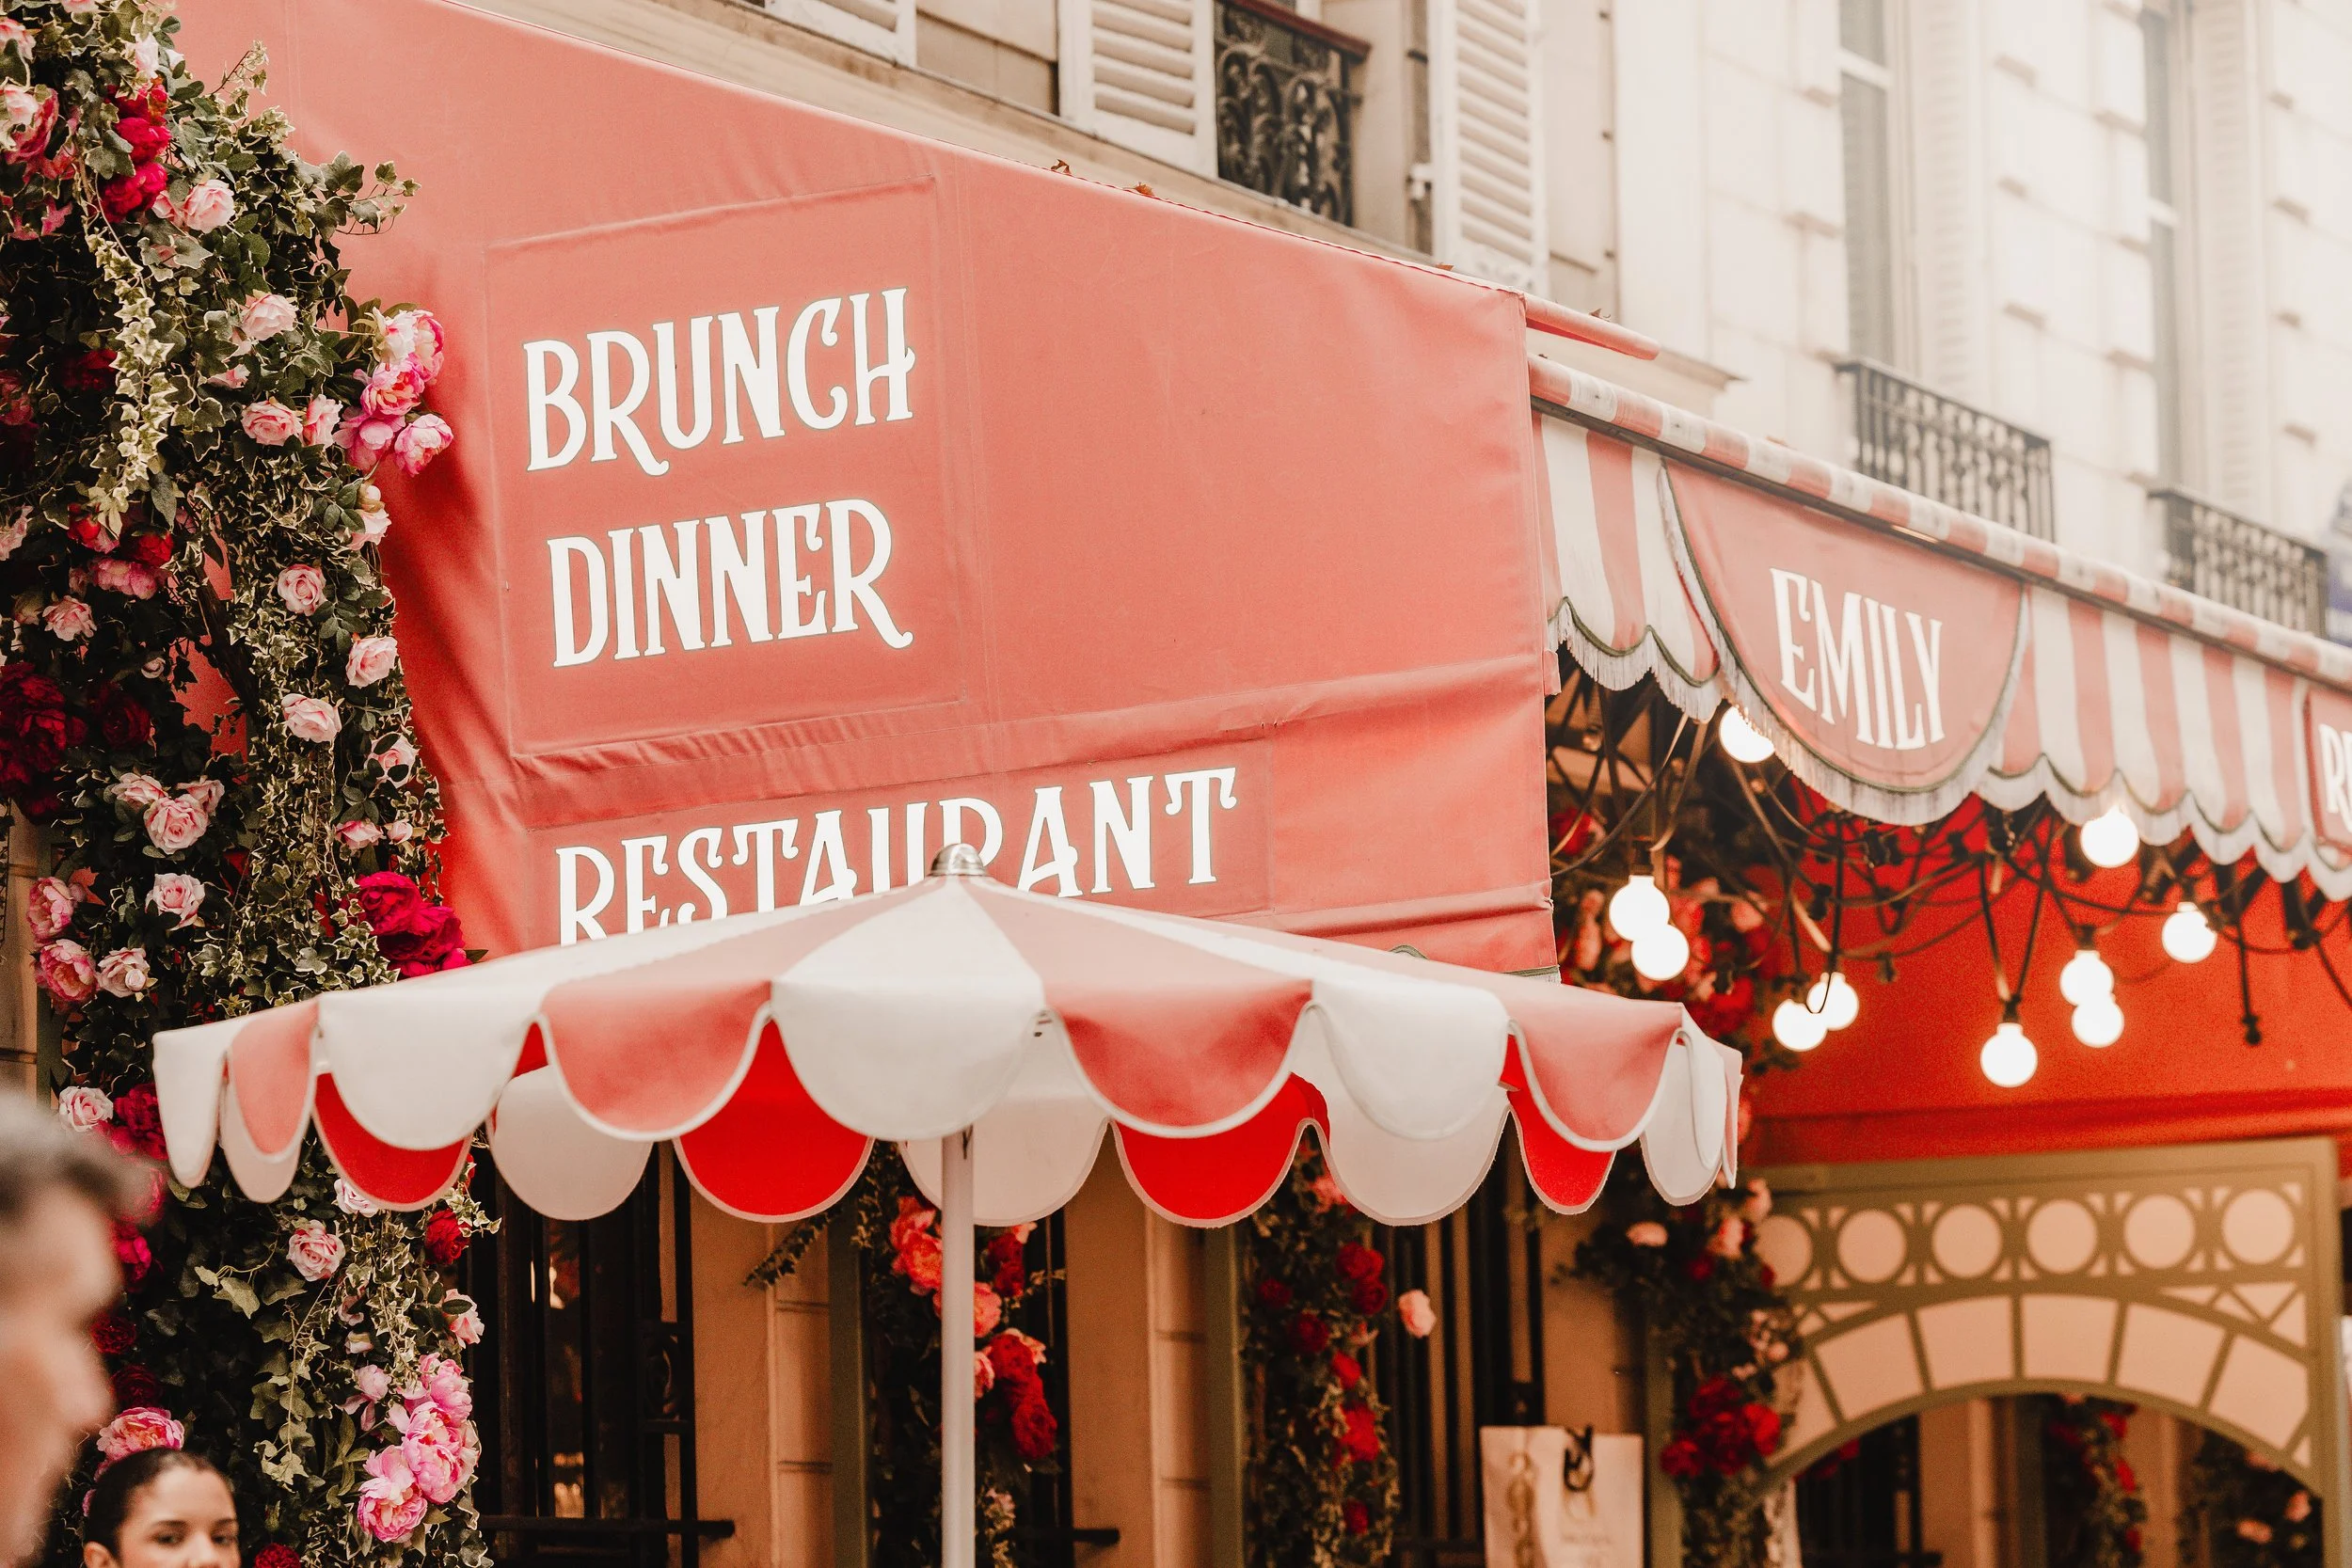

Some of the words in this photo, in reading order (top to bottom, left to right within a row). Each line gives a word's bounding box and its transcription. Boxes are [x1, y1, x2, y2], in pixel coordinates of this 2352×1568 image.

[523, 288, 915, 476] BRUNCH
[548, 499, 914, 668] DINNER
[1770, 567, 1945, 750] EMILY
